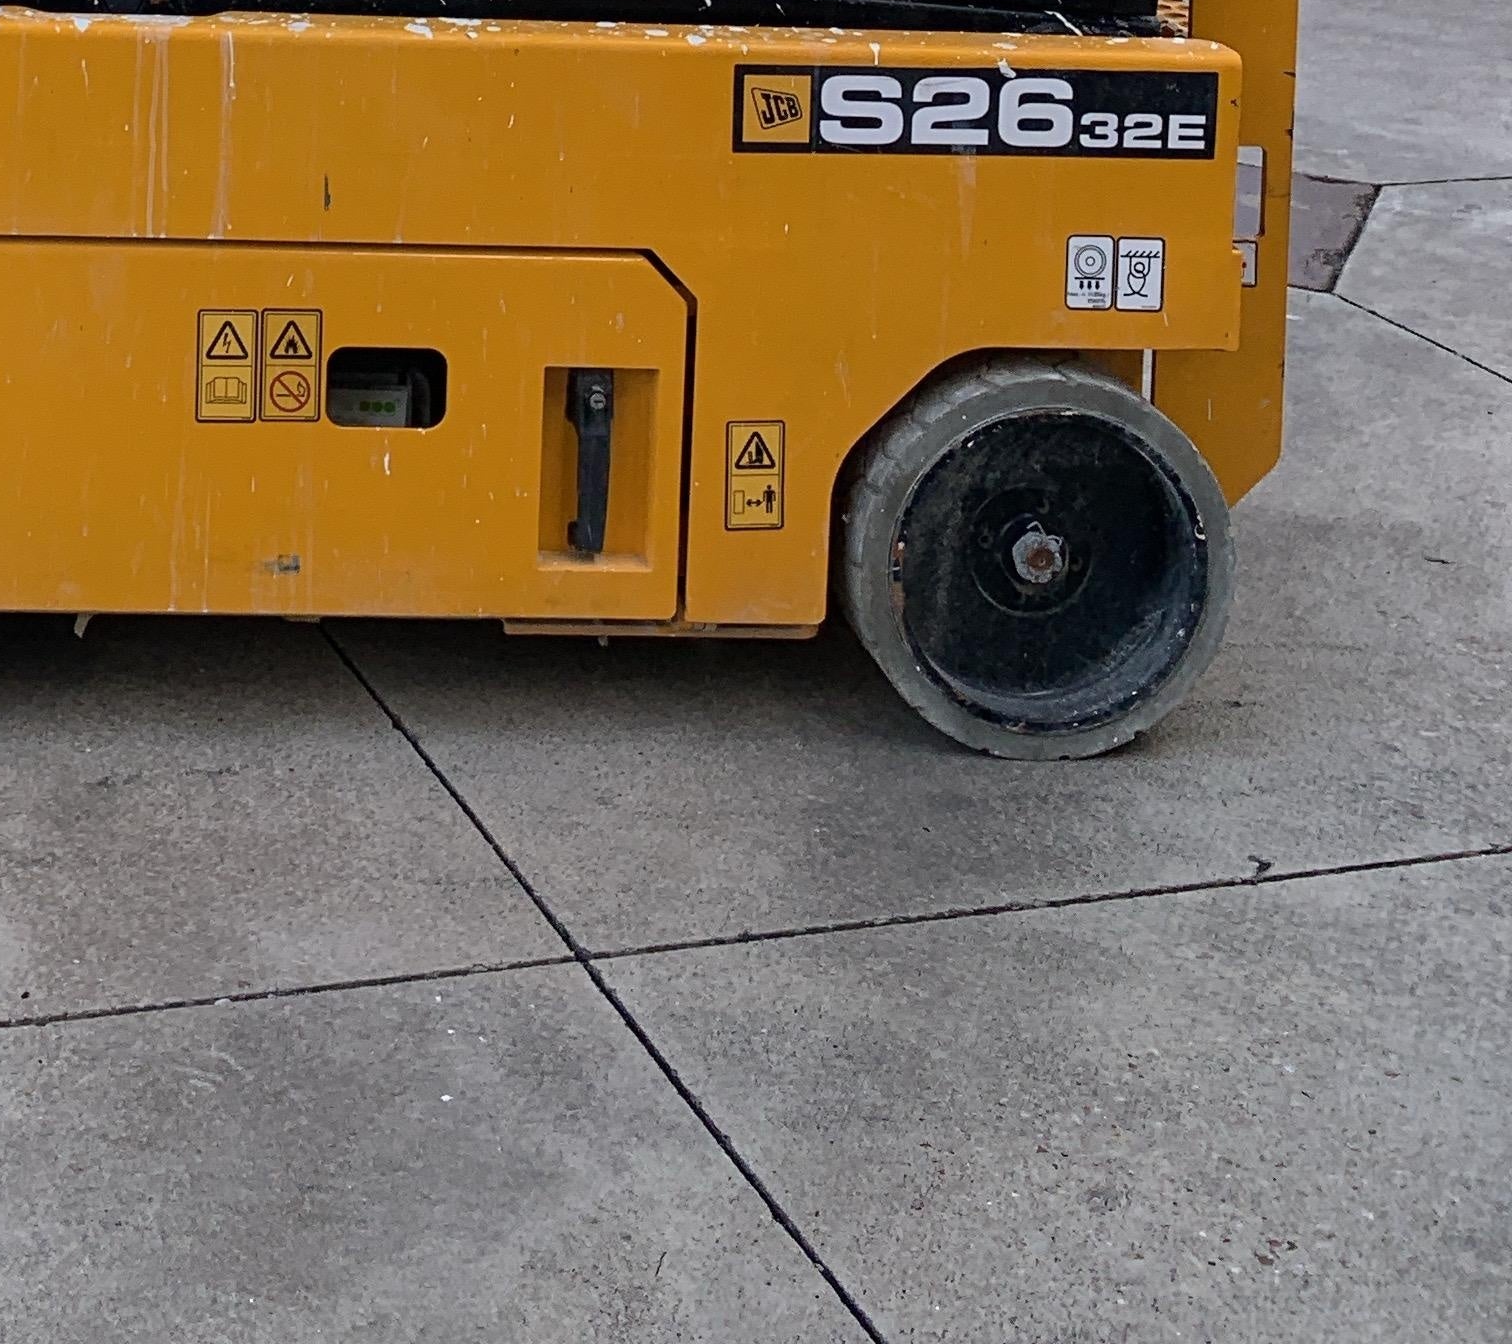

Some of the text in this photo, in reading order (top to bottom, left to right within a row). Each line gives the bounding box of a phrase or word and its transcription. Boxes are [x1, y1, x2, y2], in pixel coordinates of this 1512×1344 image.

[760, 74, 1206, 150] JCB S26 32E
